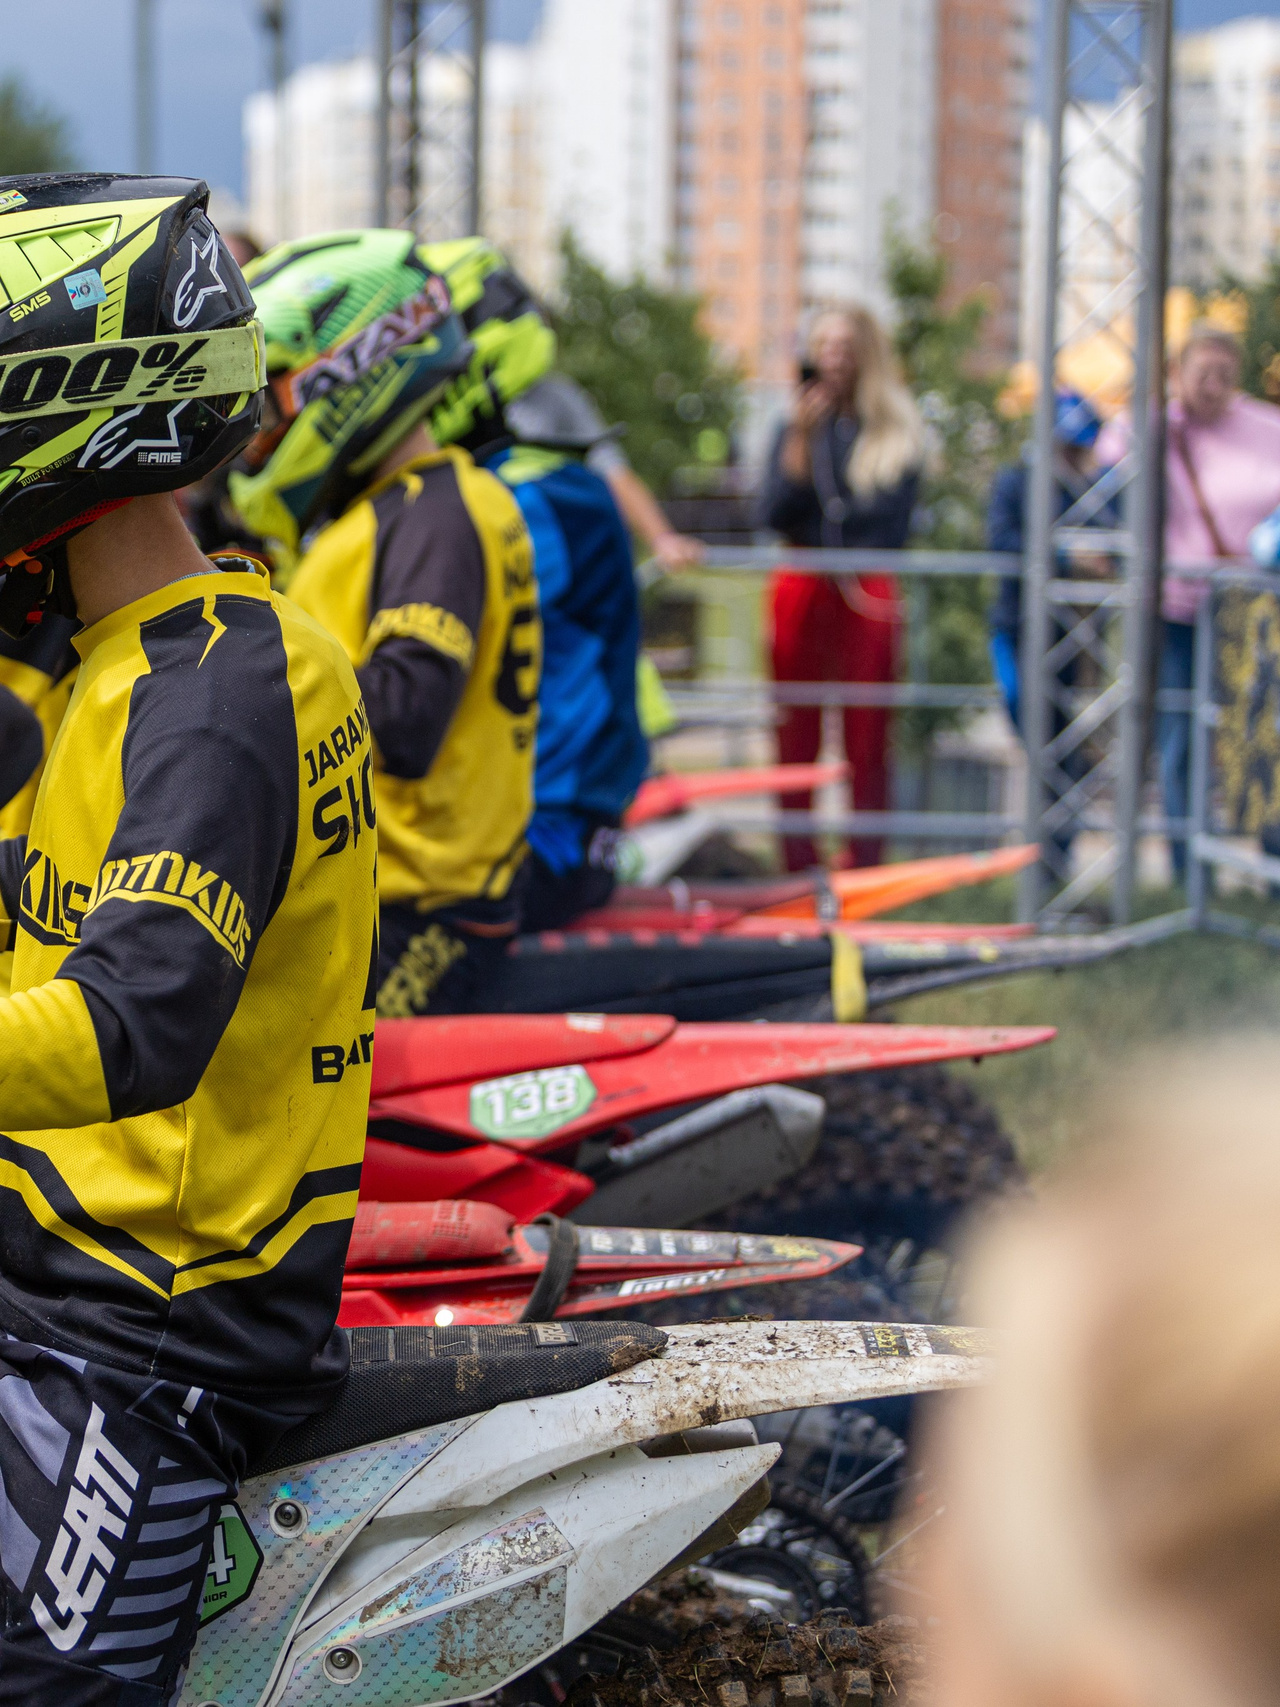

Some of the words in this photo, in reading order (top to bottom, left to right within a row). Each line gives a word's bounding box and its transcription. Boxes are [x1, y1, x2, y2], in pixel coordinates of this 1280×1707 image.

[20, 471, 41, 487] BUILT
[40, 463, 55, 476] FOR
[53, 452, 76, 469] SPEED
[485, 1077, 578, 1126] 138
[30, 1401, 140, 1651] LEATT
[206, 1522, 236, 1586] 4
